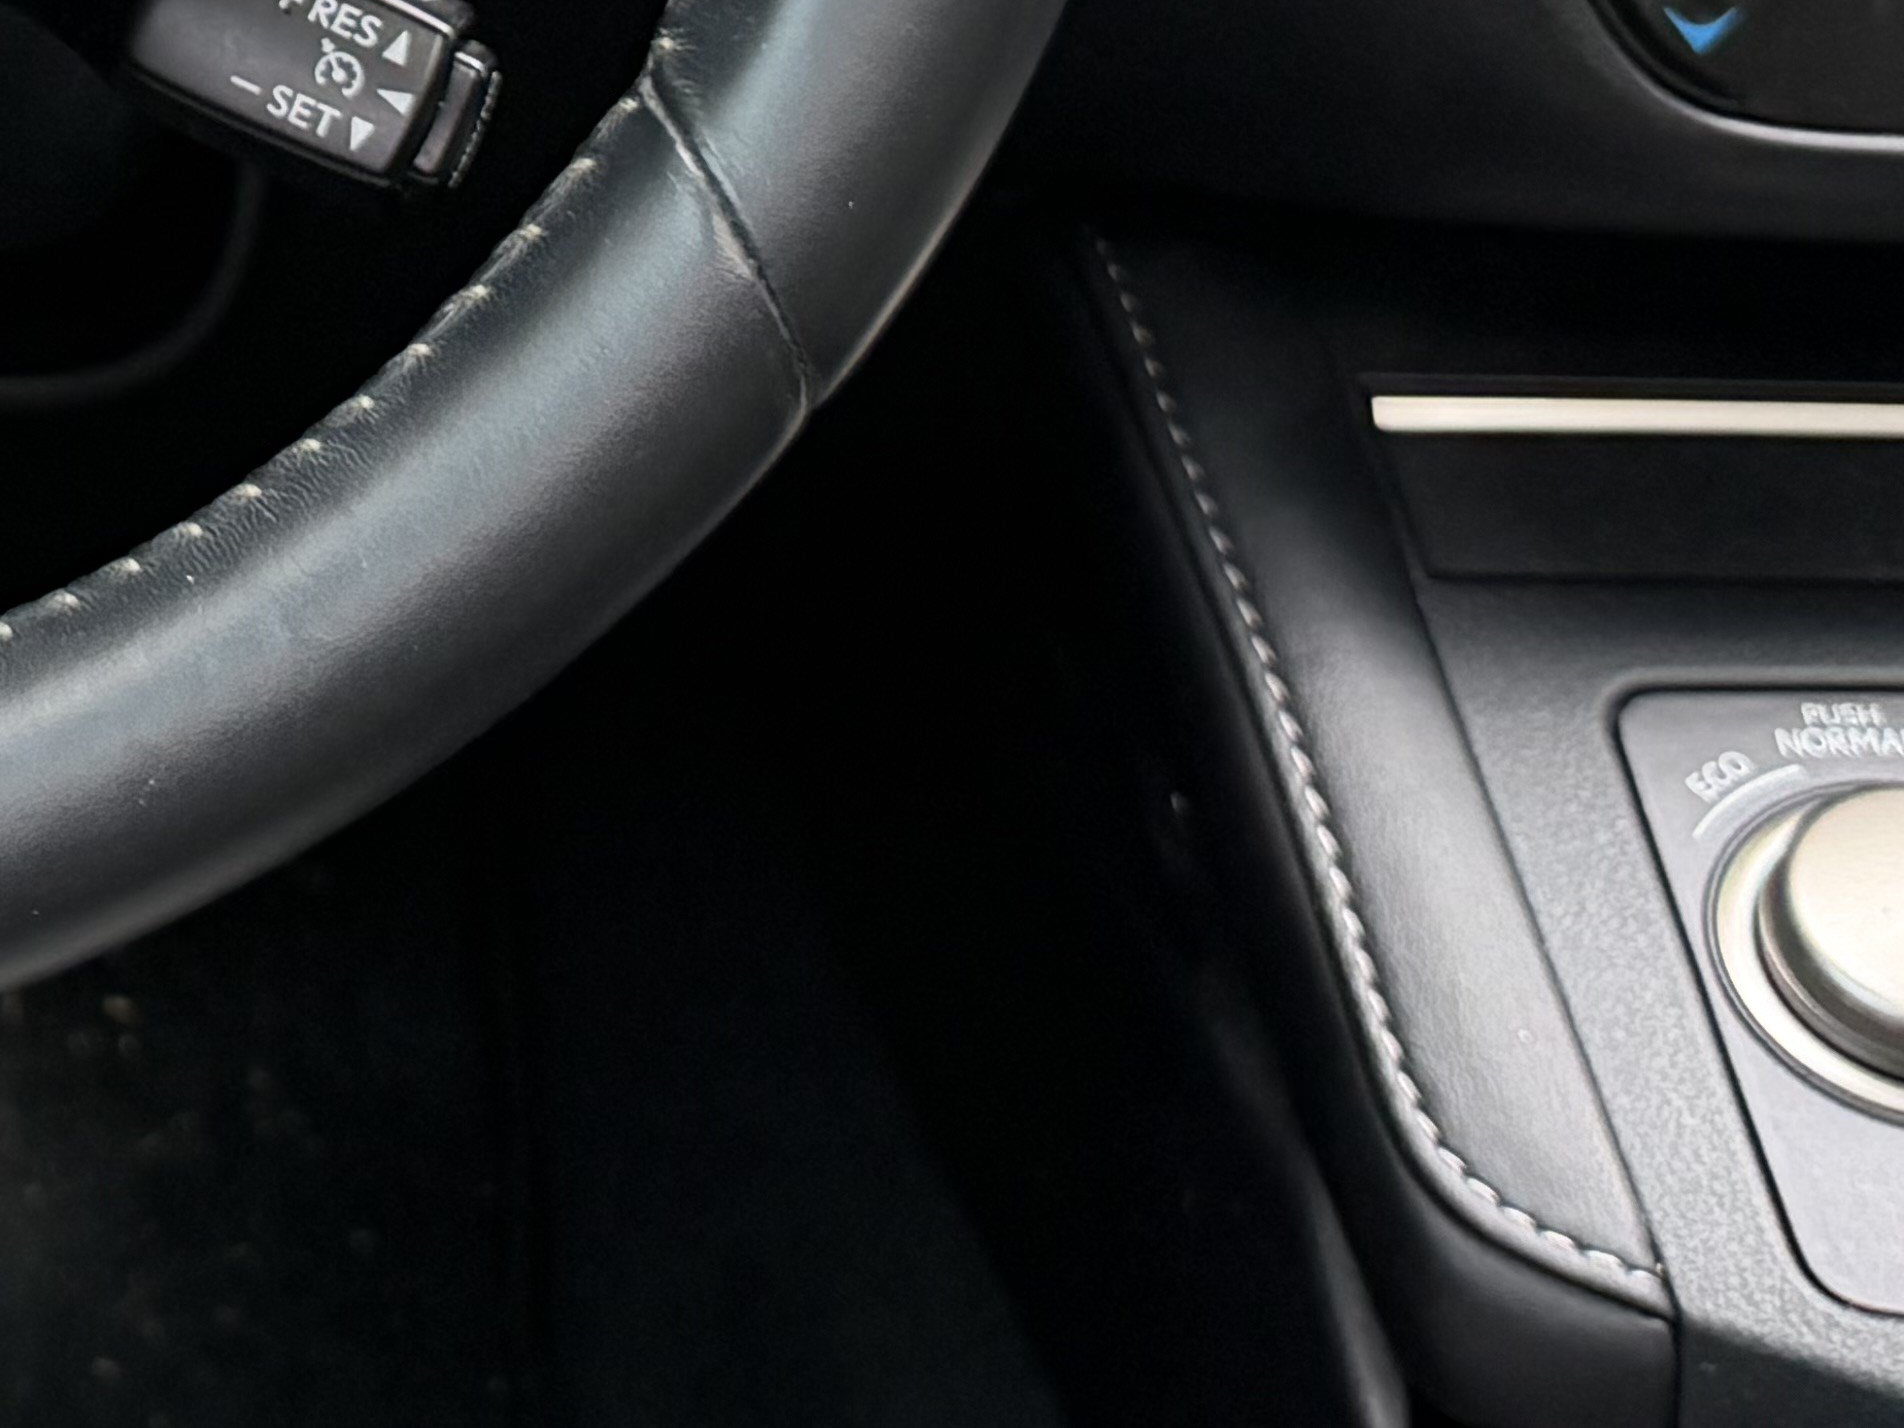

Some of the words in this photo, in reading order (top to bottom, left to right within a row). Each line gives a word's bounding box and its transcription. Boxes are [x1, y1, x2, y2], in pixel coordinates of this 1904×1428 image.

[1801, 702, 1888, 726] PUSH
[1774, 727, 1904, 759] NORMA
[1685, 751, 1757, 804] ECO
